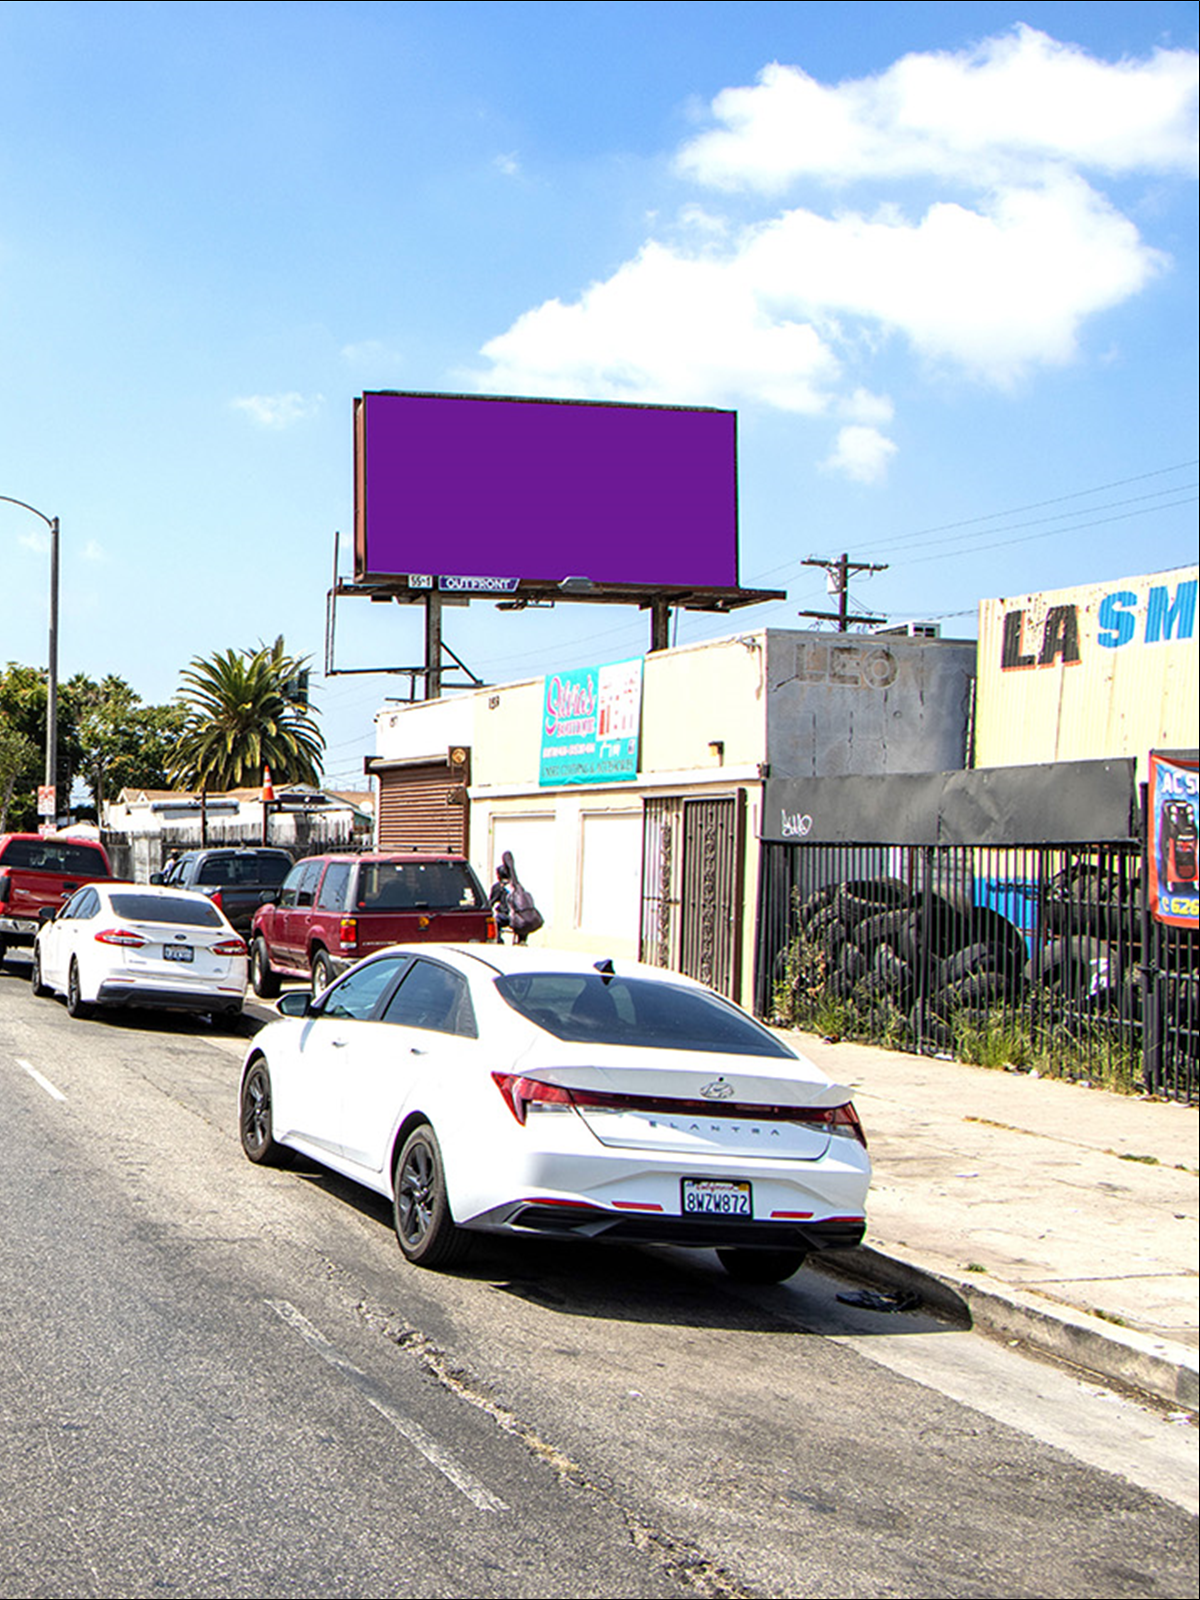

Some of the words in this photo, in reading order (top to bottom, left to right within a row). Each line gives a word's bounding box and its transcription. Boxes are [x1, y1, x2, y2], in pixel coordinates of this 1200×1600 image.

[446, 577, 511, 590] OUTFRONT
[1001, 604, 1082, 672] LA
[1162, 772, 1183, 794] AC
[648, 1121, 780, 1136] ELANTRA
[687, 1193, 748, 1214] 8WZW872
